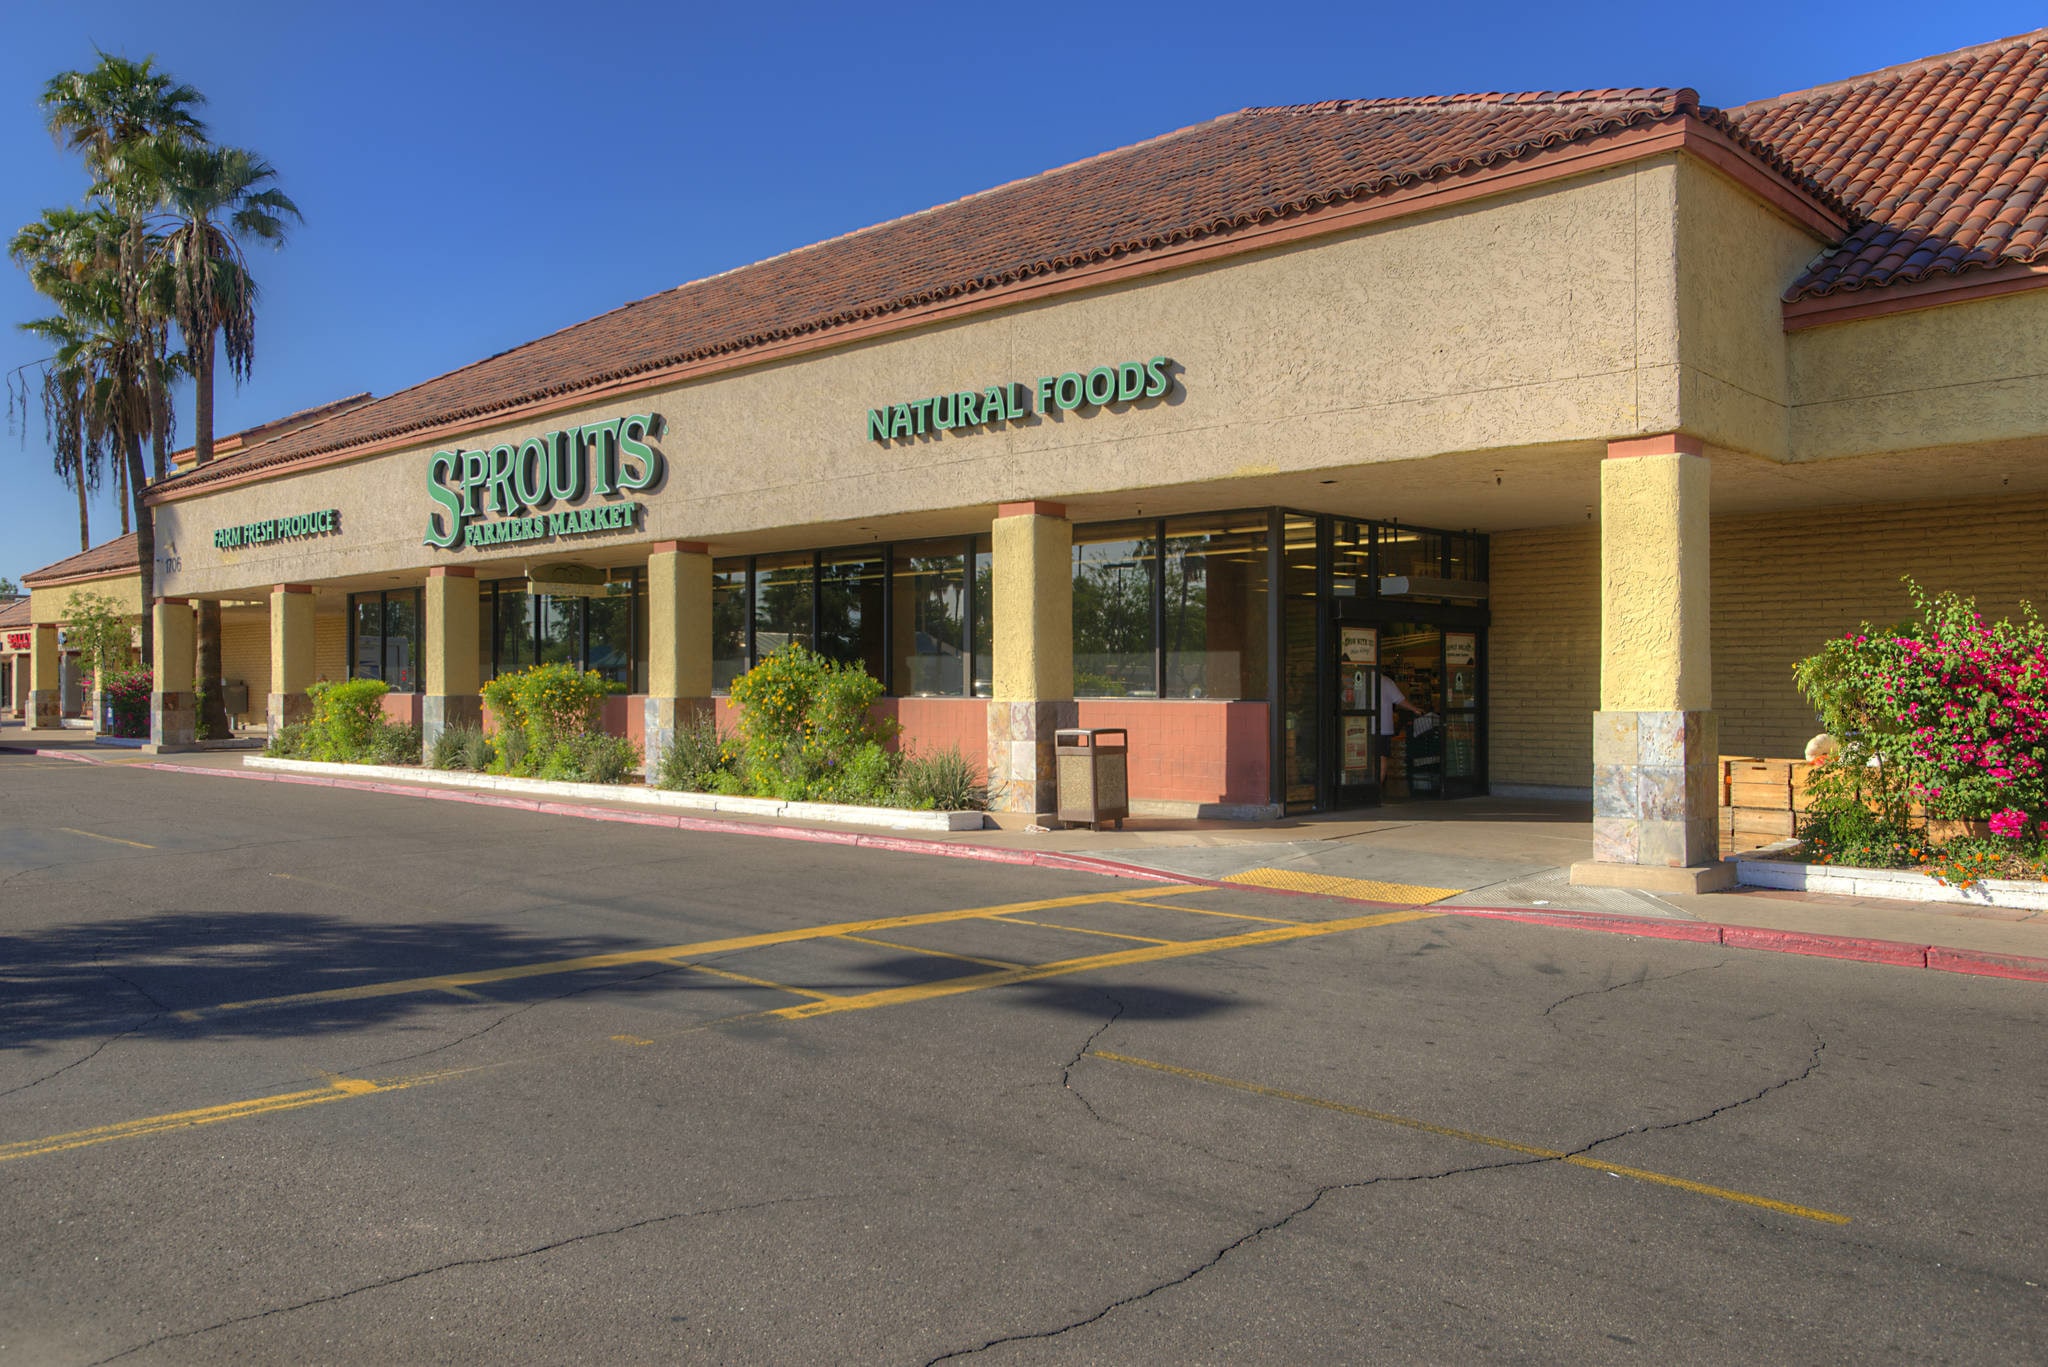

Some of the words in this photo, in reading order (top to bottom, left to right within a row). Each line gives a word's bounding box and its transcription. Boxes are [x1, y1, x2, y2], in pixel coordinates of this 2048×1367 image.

[867, 382, 1025, 441] NATURAL
[1037, 356, 1168, 414] FOODS
[423, 412, 658, 548] SPROUTS
[213, 527, 241, 548] FARM
[244, 519, 275, 544] FRESH
[278, 509, 334, 539] PRODUCE
[464, 515, 545, 546] FARMERS
[548, 502, 638, 536] MARKET
